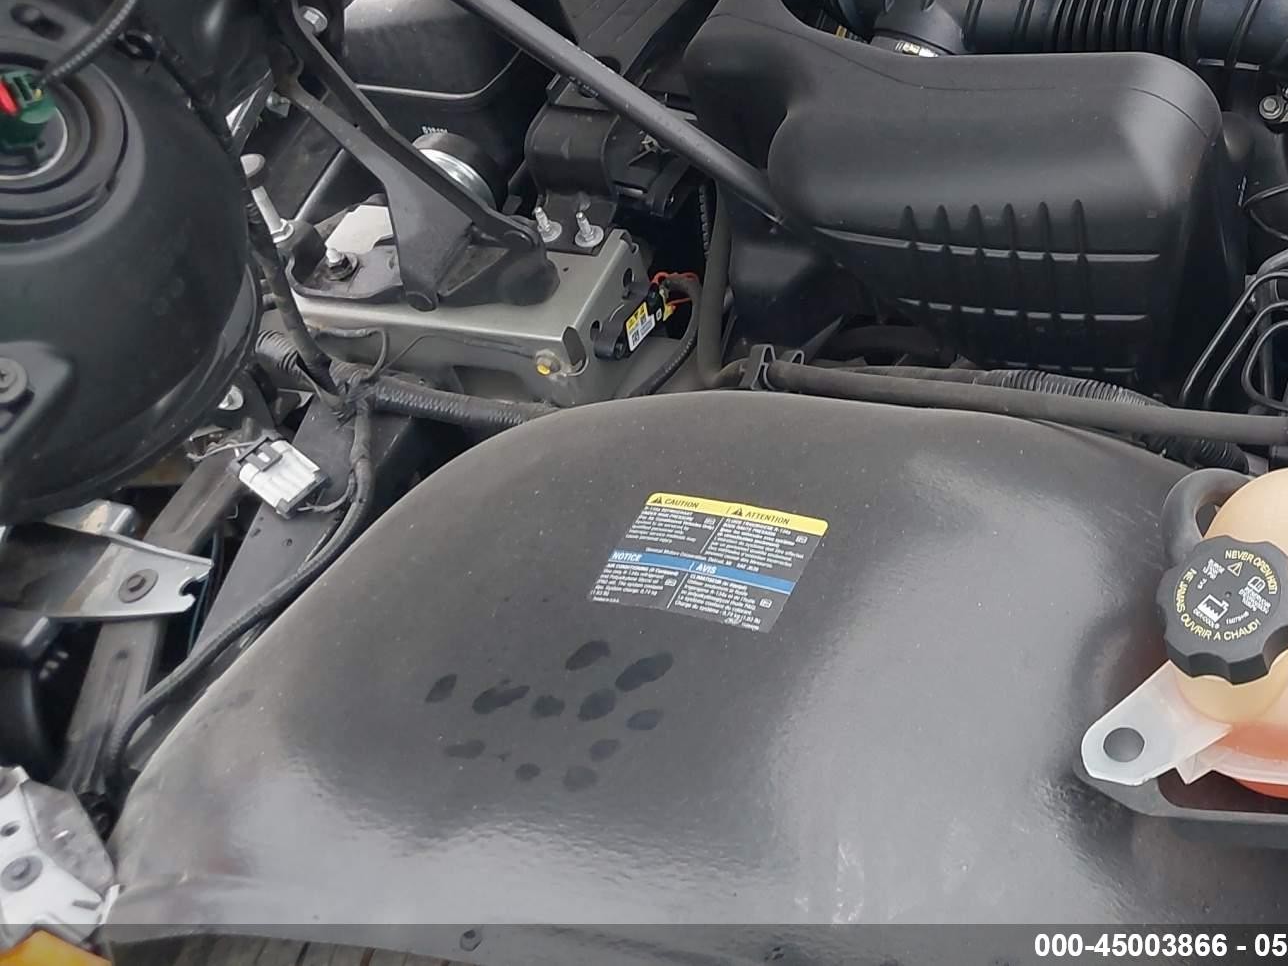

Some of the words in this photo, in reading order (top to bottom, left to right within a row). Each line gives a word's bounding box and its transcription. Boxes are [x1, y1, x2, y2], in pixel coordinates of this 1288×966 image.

[664, 497, 700, 509] CAUTION
[745, 511, 791, 525] ATTENTION
[612, 551, 642, 563] NOTICE
[696, 562, 717, 575] AVIS
[1224, 549, 1255, 564] NEVER
[1253, 557, 1273, 580] OPEN
[1181, 614, 1213, 641] OUVRIR
